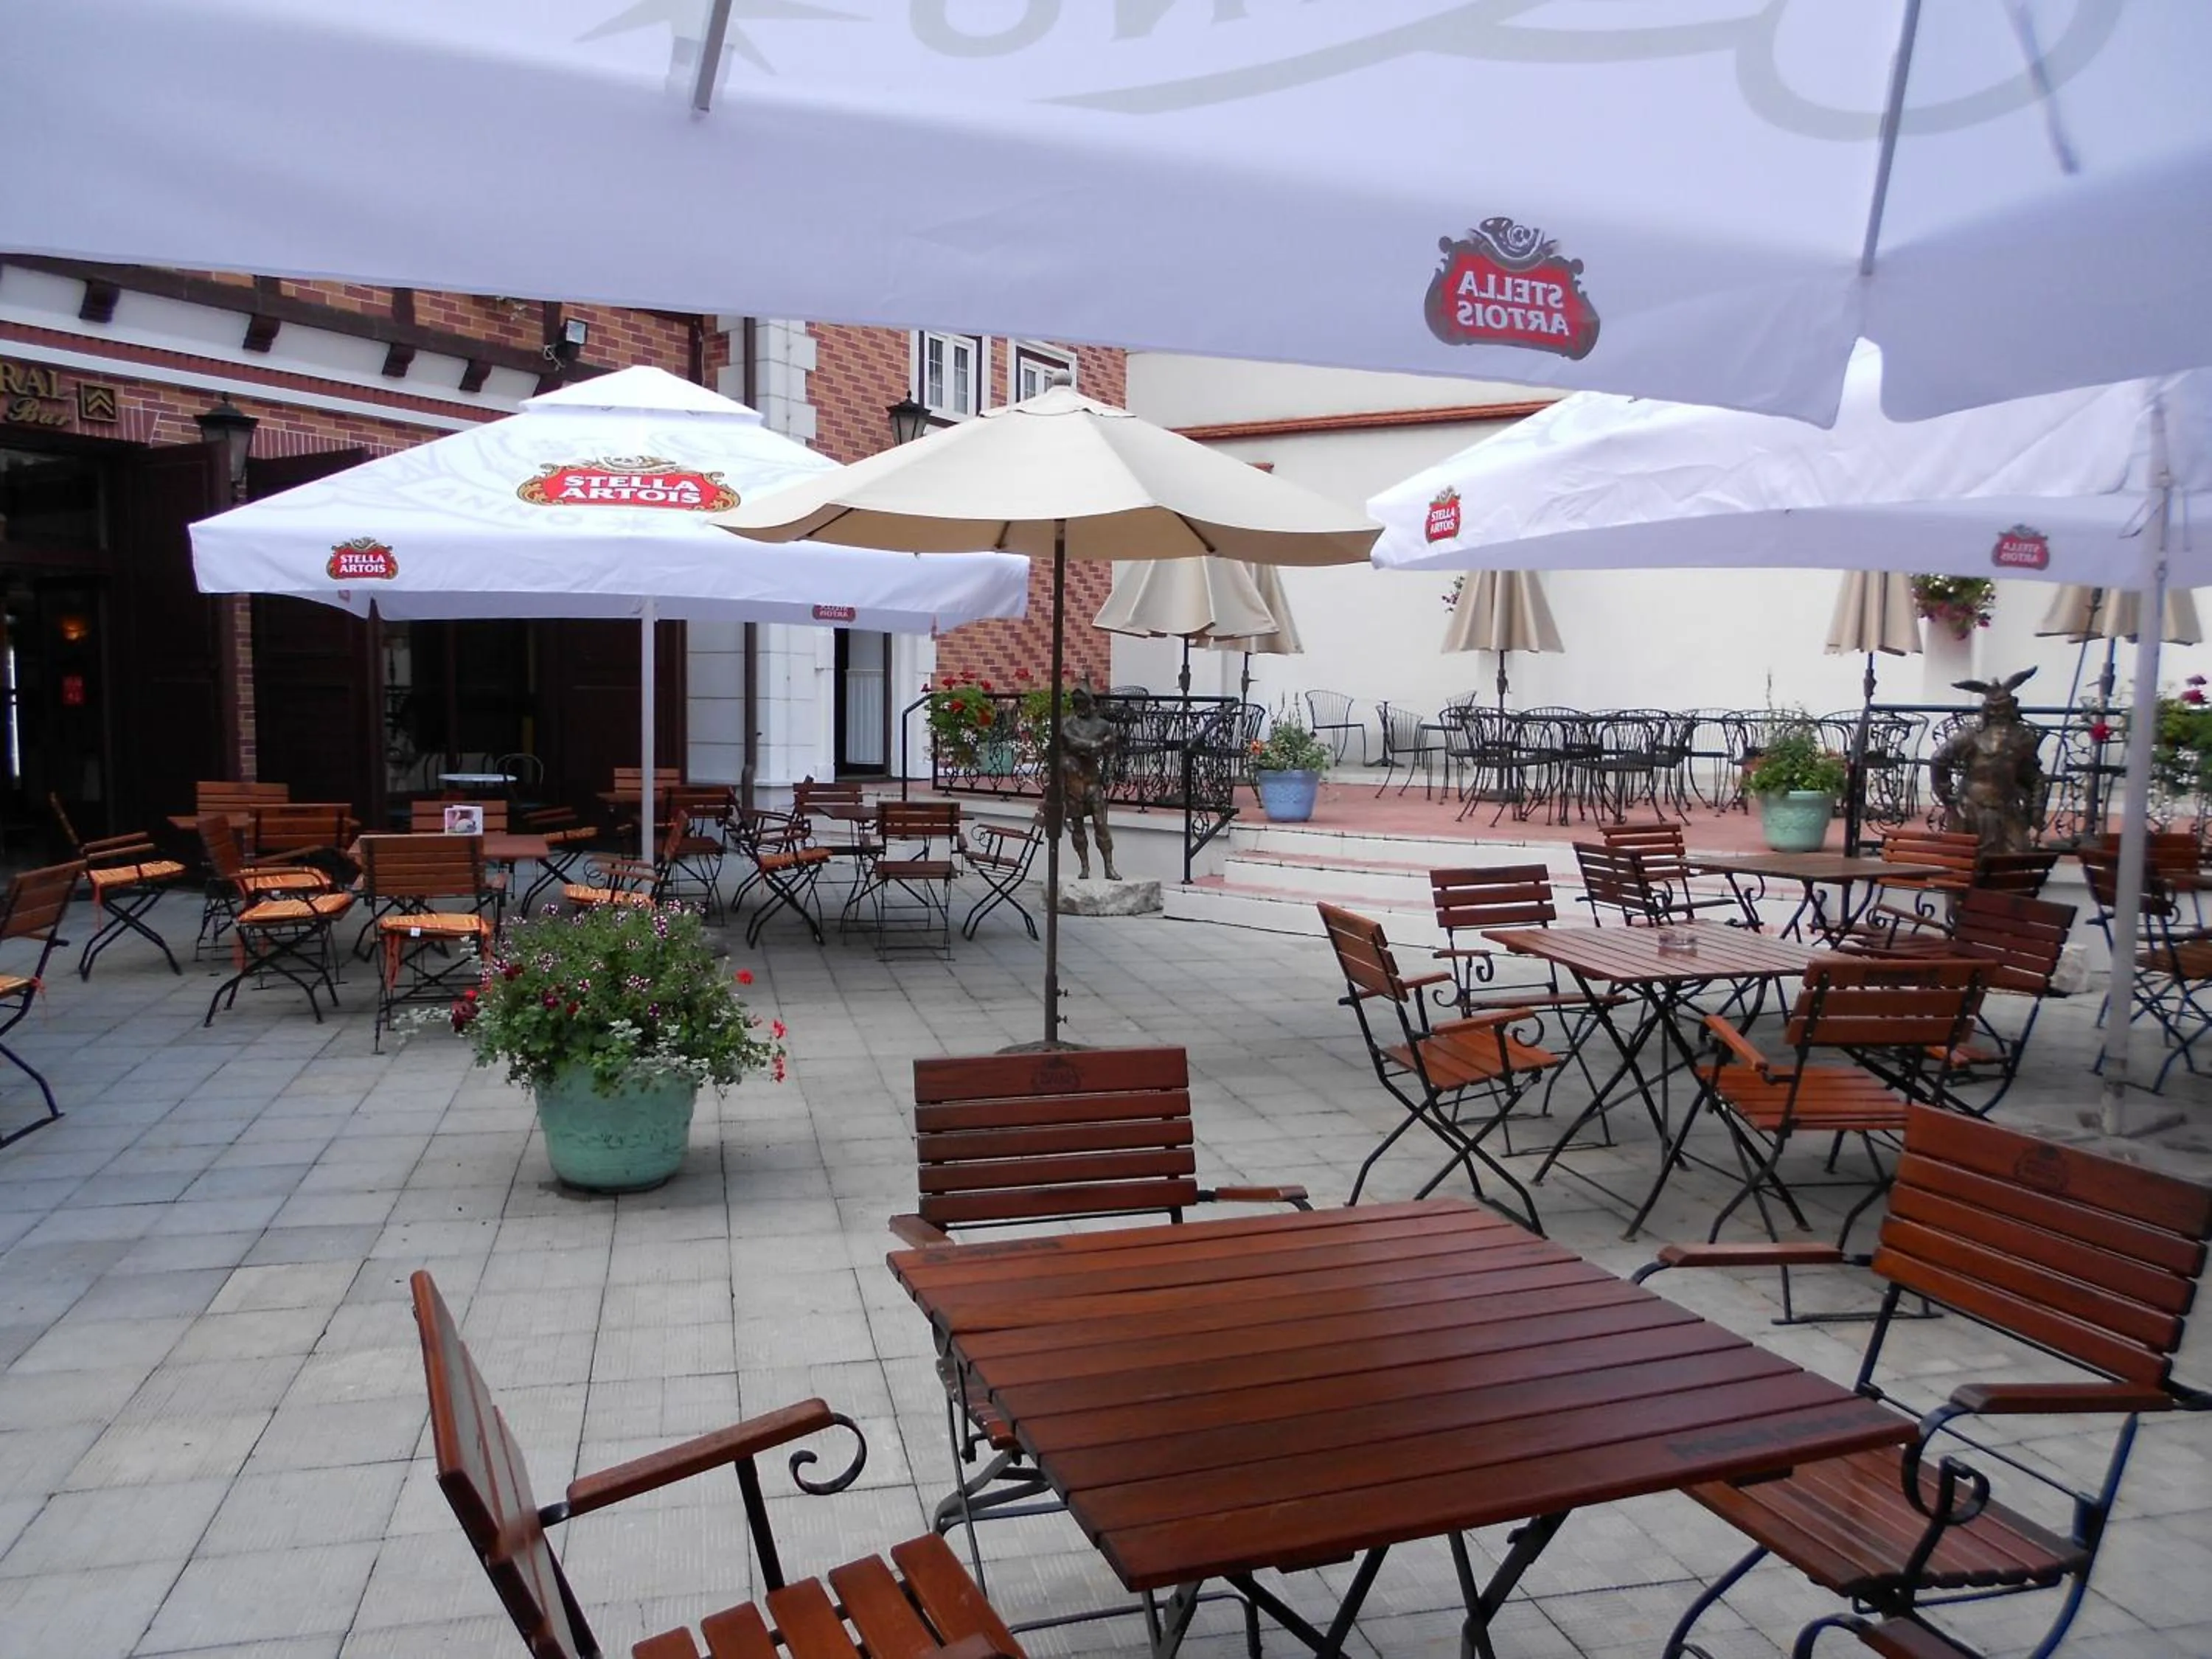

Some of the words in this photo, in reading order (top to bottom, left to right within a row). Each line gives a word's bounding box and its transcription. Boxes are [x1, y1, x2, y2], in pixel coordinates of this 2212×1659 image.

[8, 397, 72, 426] Bar
[563, 475, 700, 492] STELLA
[559, 487, 701, 504] ARTOIS
[339, 554, 386, 563] STELLA
[339, 564, 386, 573] ARTOIS
